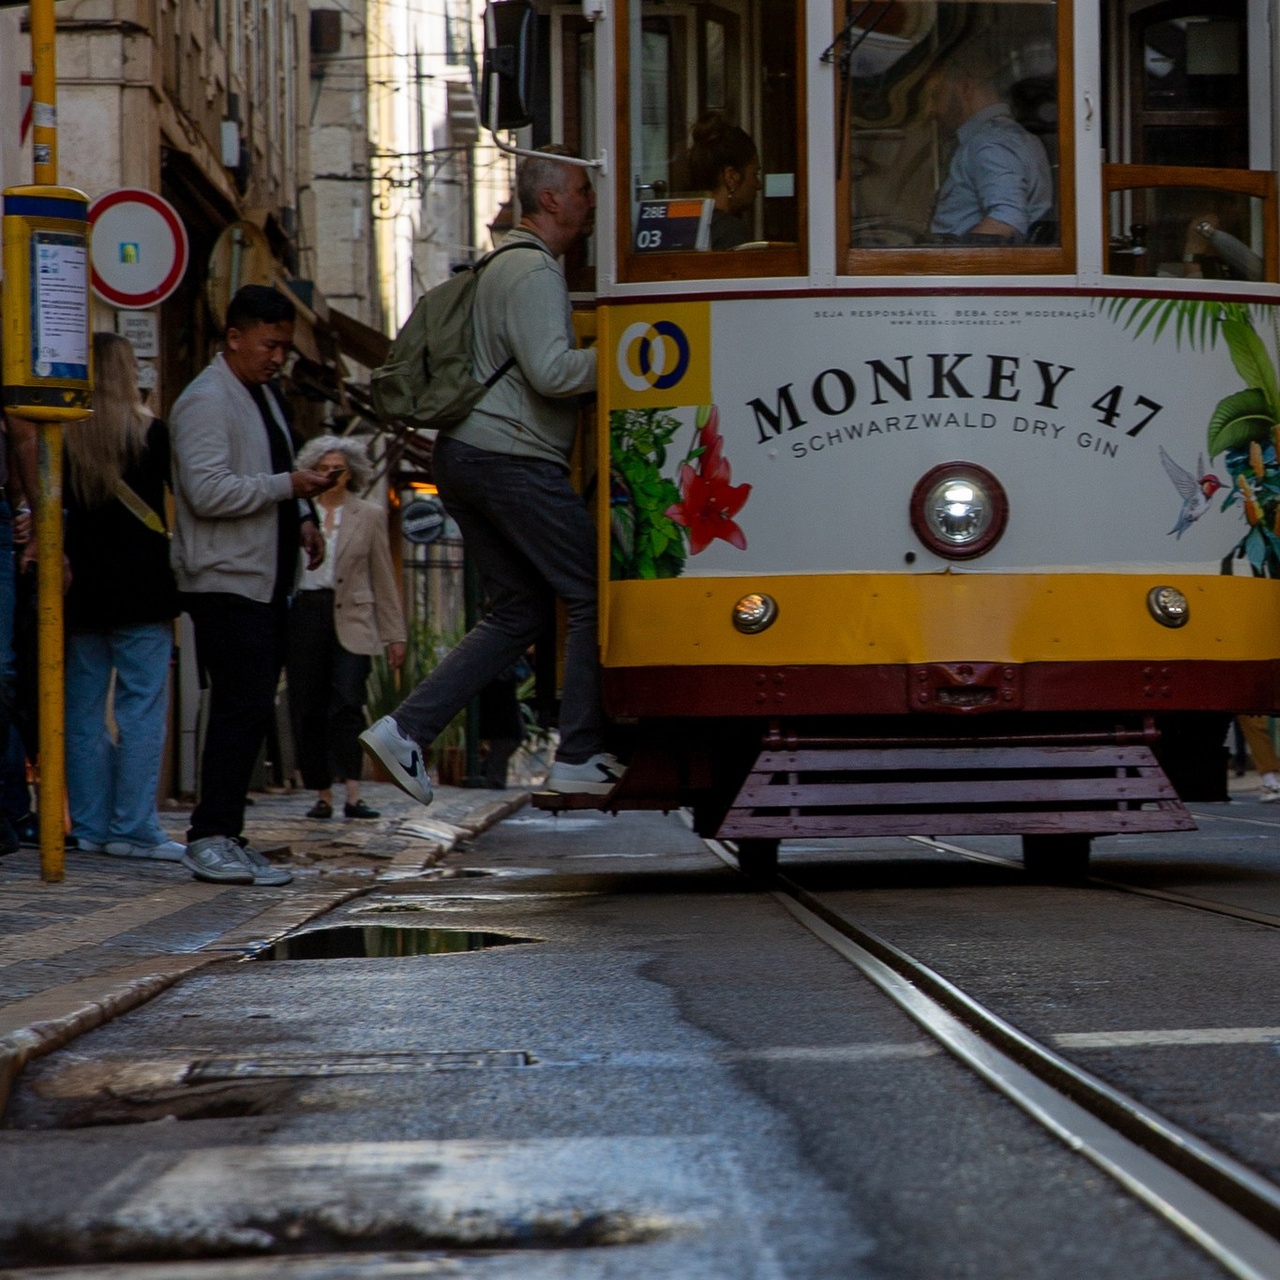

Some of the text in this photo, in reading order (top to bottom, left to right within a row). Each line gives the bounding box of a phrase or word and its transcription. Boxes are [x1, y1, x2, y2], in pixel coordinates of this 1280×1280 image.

[641, 206, 667, 219] 28E
[636, 229, 662, 249] 03
[814, 308, 1096, 320] SEJA RESPONSÁVEL BEBA COM MODERAÇÃO
[745, 352, 1164, 445] MONKEY 47
[791, 412, 1120, 460] SCHWARZWALD DRY GIN
